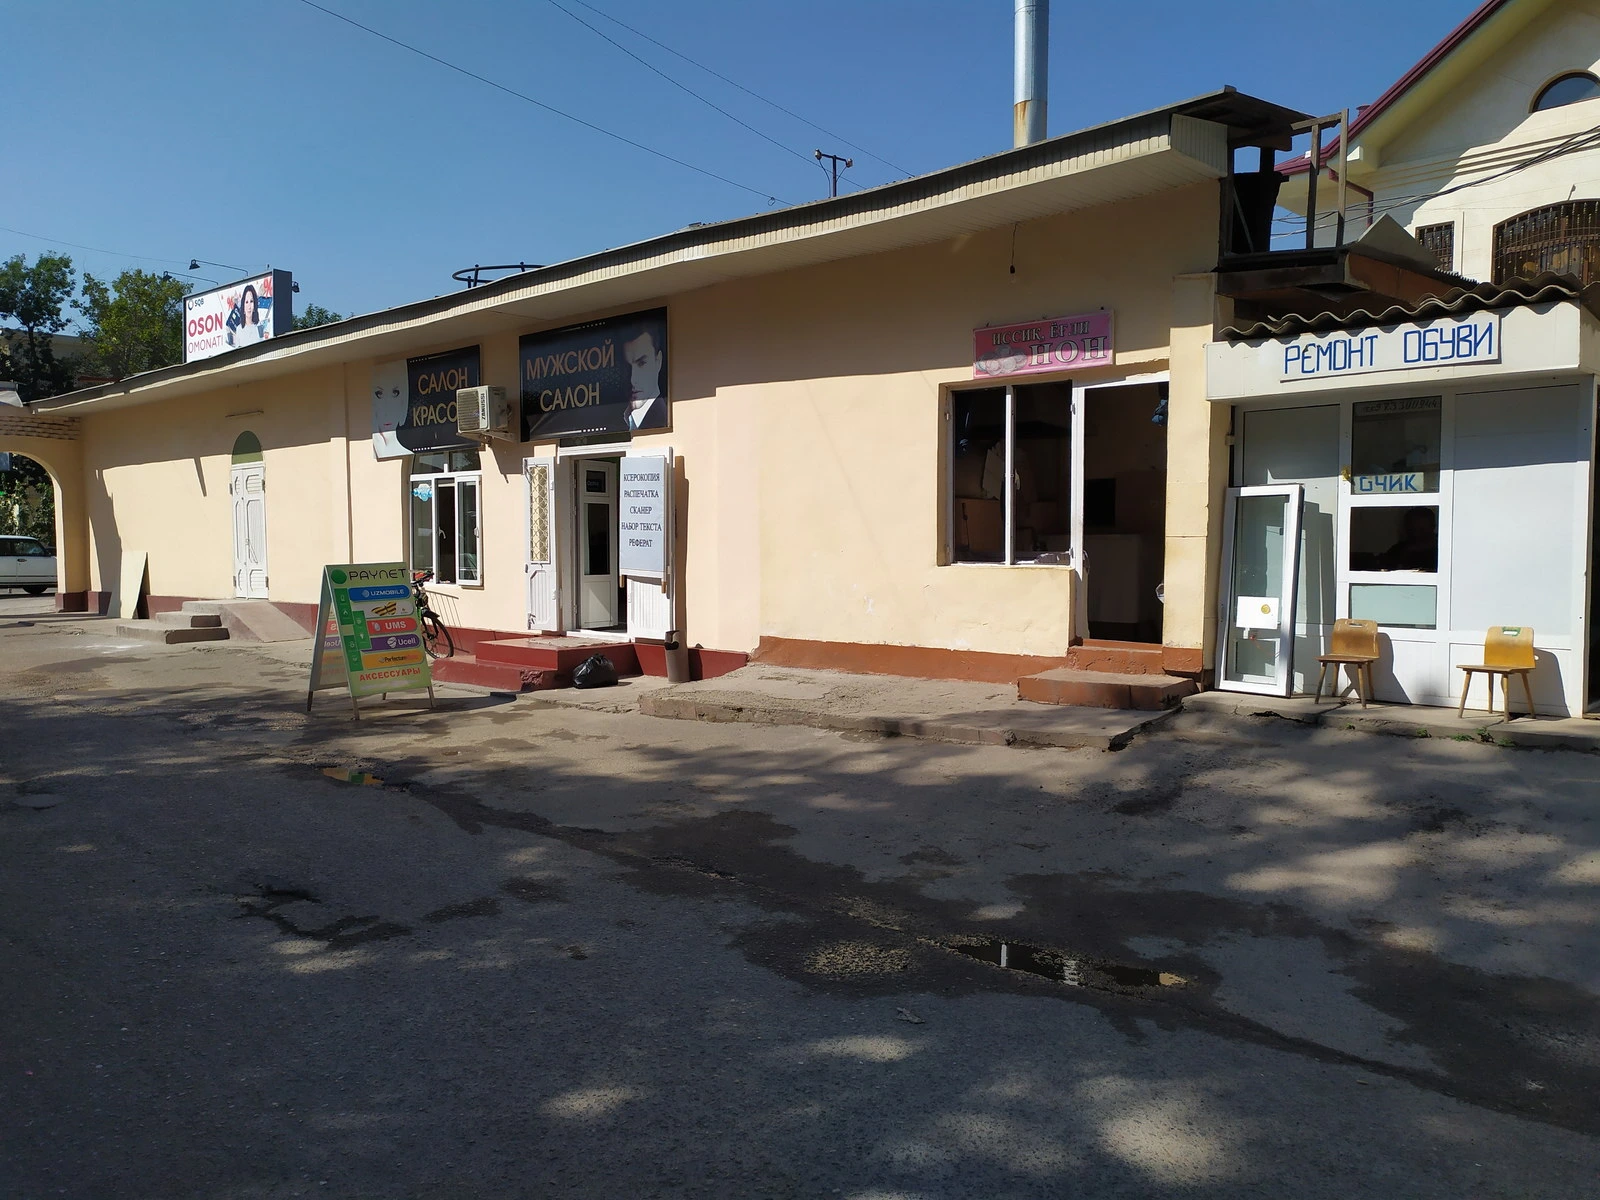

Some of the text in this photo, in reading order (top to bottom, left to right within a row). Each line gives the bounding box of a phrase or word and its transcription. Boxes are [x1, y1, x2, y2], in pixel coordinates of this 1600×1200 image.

[194, 298, 204, 308] SQB
[188, 312, 223, 337] OSON
[188, 335, 224, 353] OMONATI
[1284, 321, 1493, 375] РЕМОНТ ОБУВИ
[1029, 335, 1108, 367] НОН
[526, 338, 615, 380] МУЖСКОЙ
[418, 367, 468, 395] САЛОН
[540, 382, 600, 412] САЛОН
[413, 401, 458, 427] КРАСО
[623, 473, 660, 482] КСЕРОКОПИЯ
[623, 490, 659, 498] РАСПЕЧАТКА
[629, 506, 652, 514] СКАНЕР
[621, 522, 662, 531] НАБОР ТЕКСТА
[629, 538, 653, 547] РЕФЕРАТ
[348, 568, 407, 581] PAYNET
[385, 620, 407, 630] UMS
[398, 637, 416, 646] Ucell
[359, 667, 421, 681] АКСЕССУАРЫ
